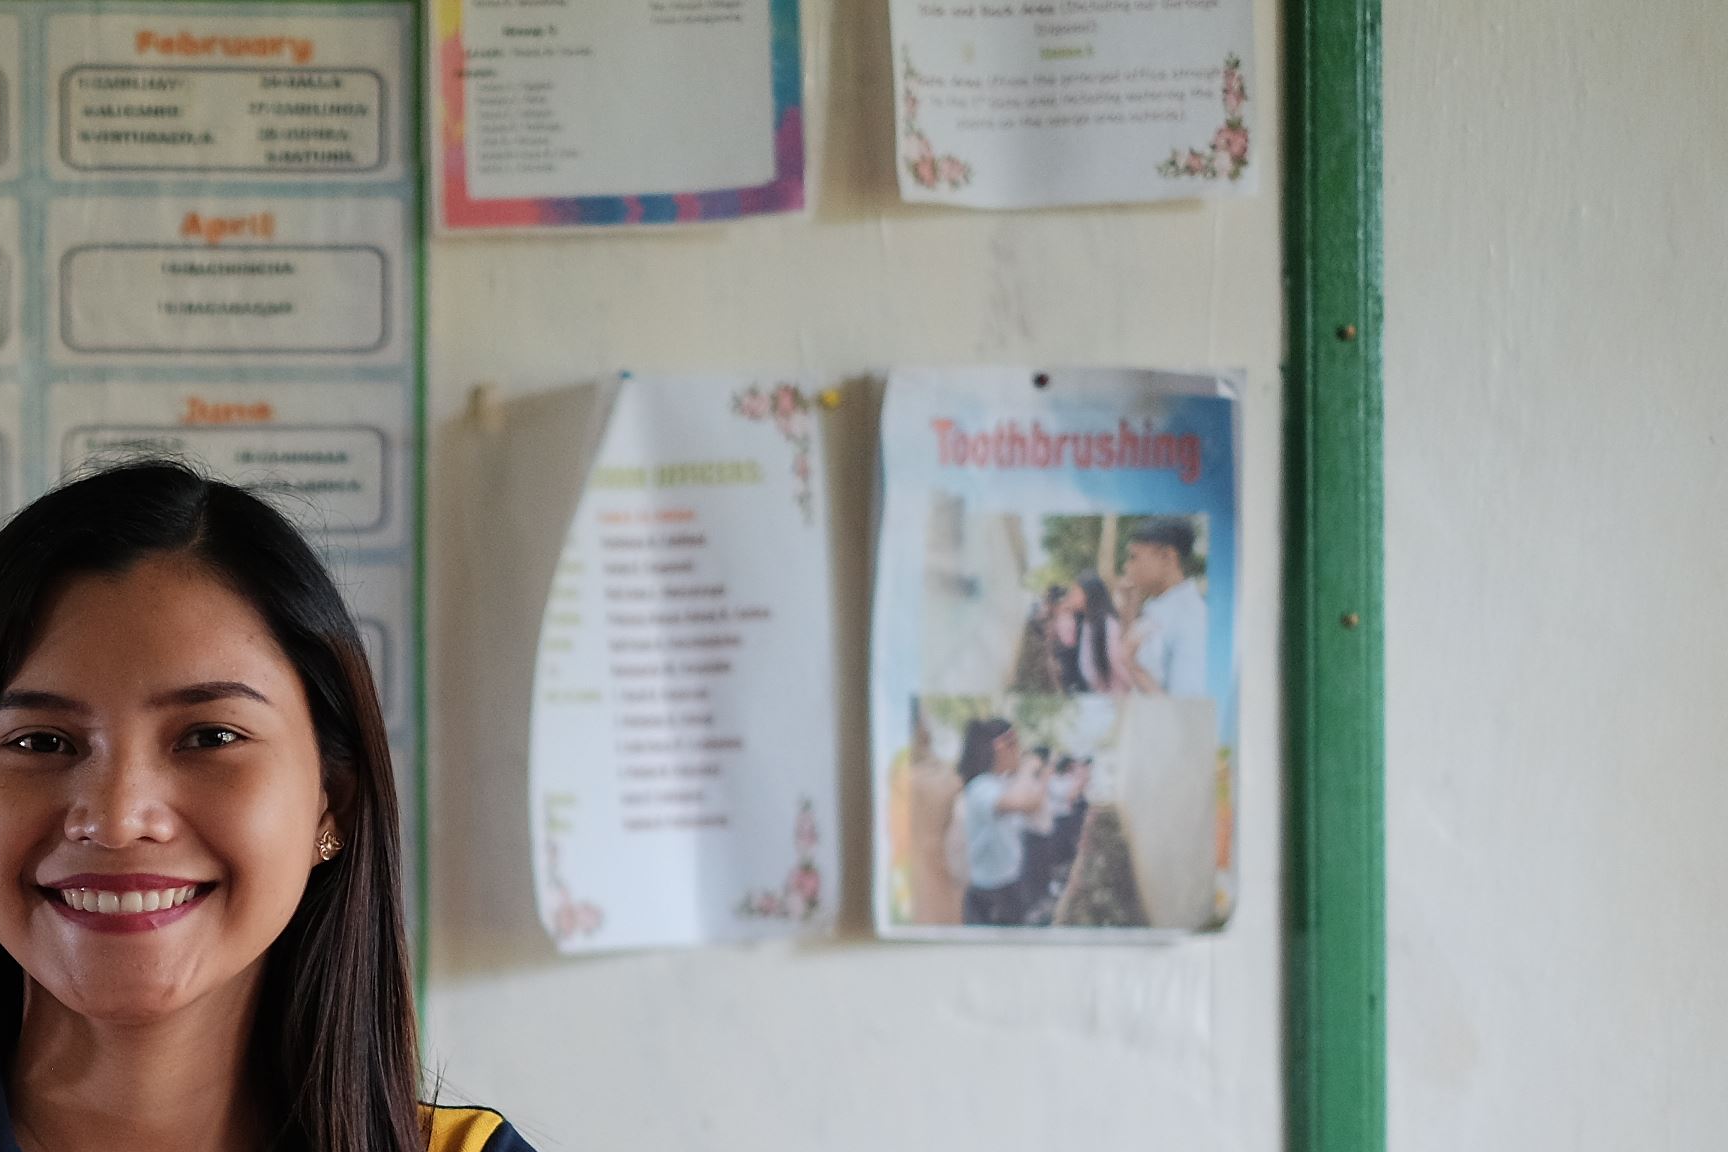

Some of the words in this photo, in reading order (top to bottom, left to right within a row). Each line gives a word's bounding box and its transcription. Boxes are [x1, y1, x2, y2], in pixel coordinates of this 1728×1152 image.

[134, 30, 316, 66] February
[180, 211, 277, 245] April
[181, 395, 275, 425] June
[929, 415, 1204, 484] Toothbrushing
